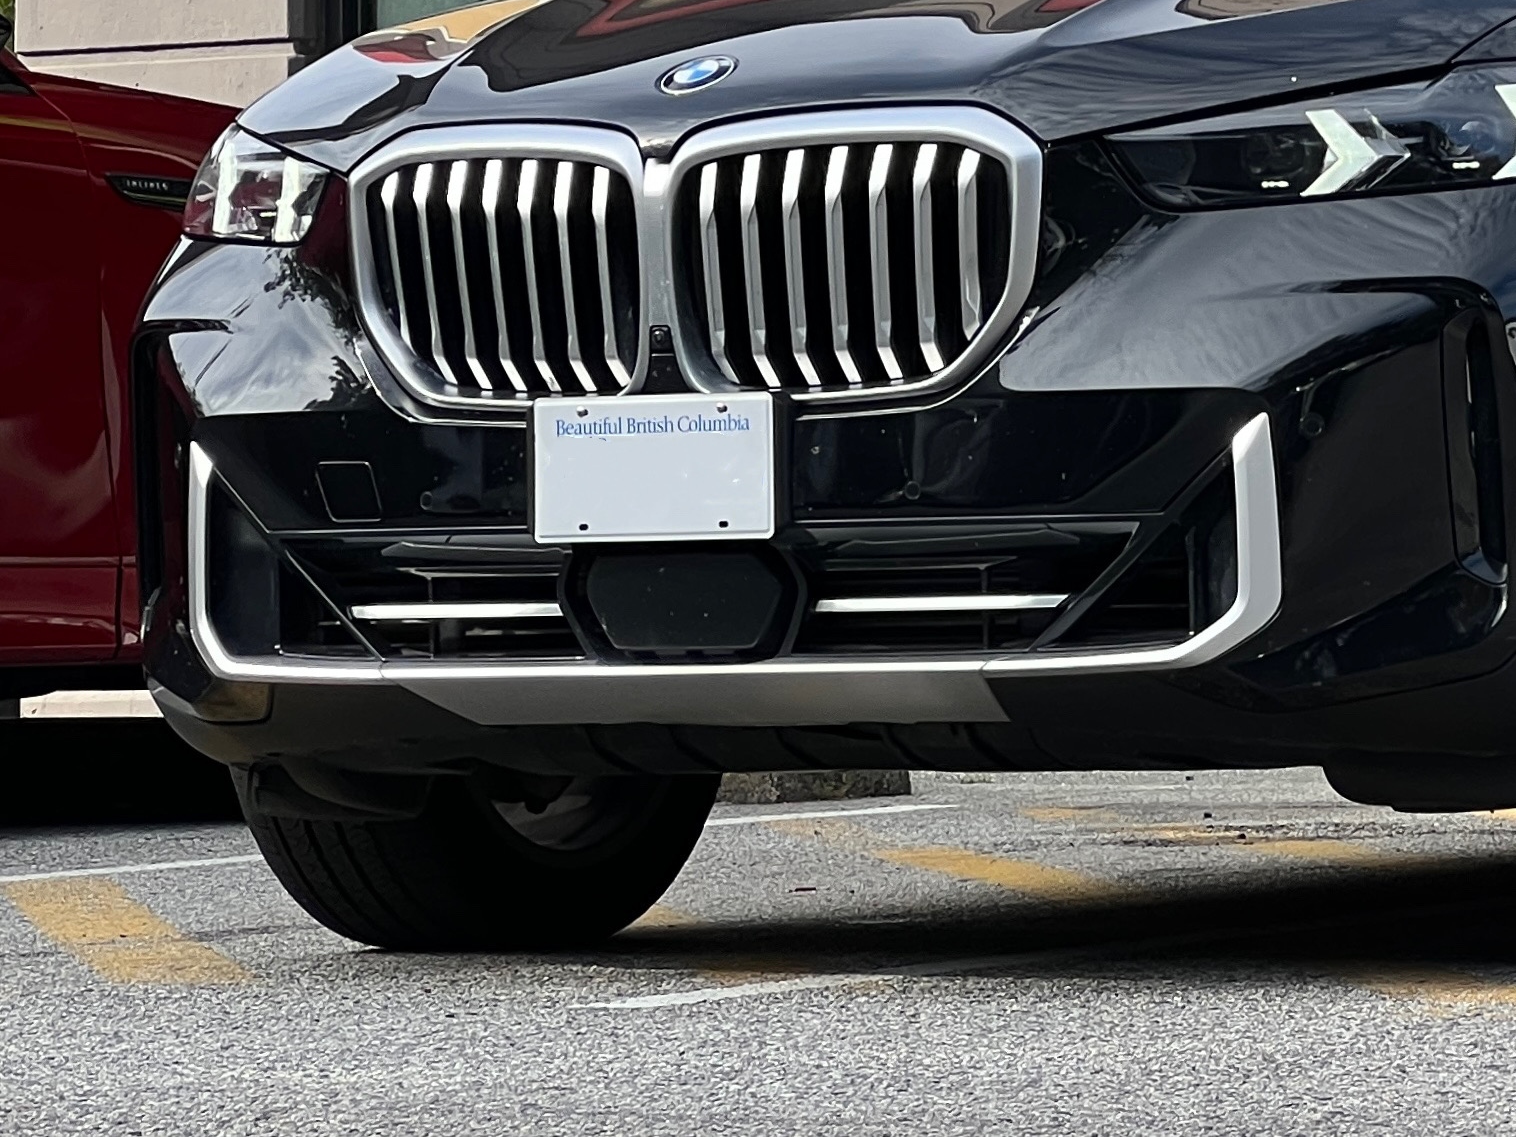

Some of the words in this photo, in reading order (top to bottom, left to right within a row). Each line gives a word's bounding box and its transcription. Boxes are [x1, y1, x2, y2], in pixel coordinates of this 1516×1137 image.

[555, 415, 622, 437] Beautiful
[626, 415, 674, 435] British
[677, 414, 750, 433] Columbia
